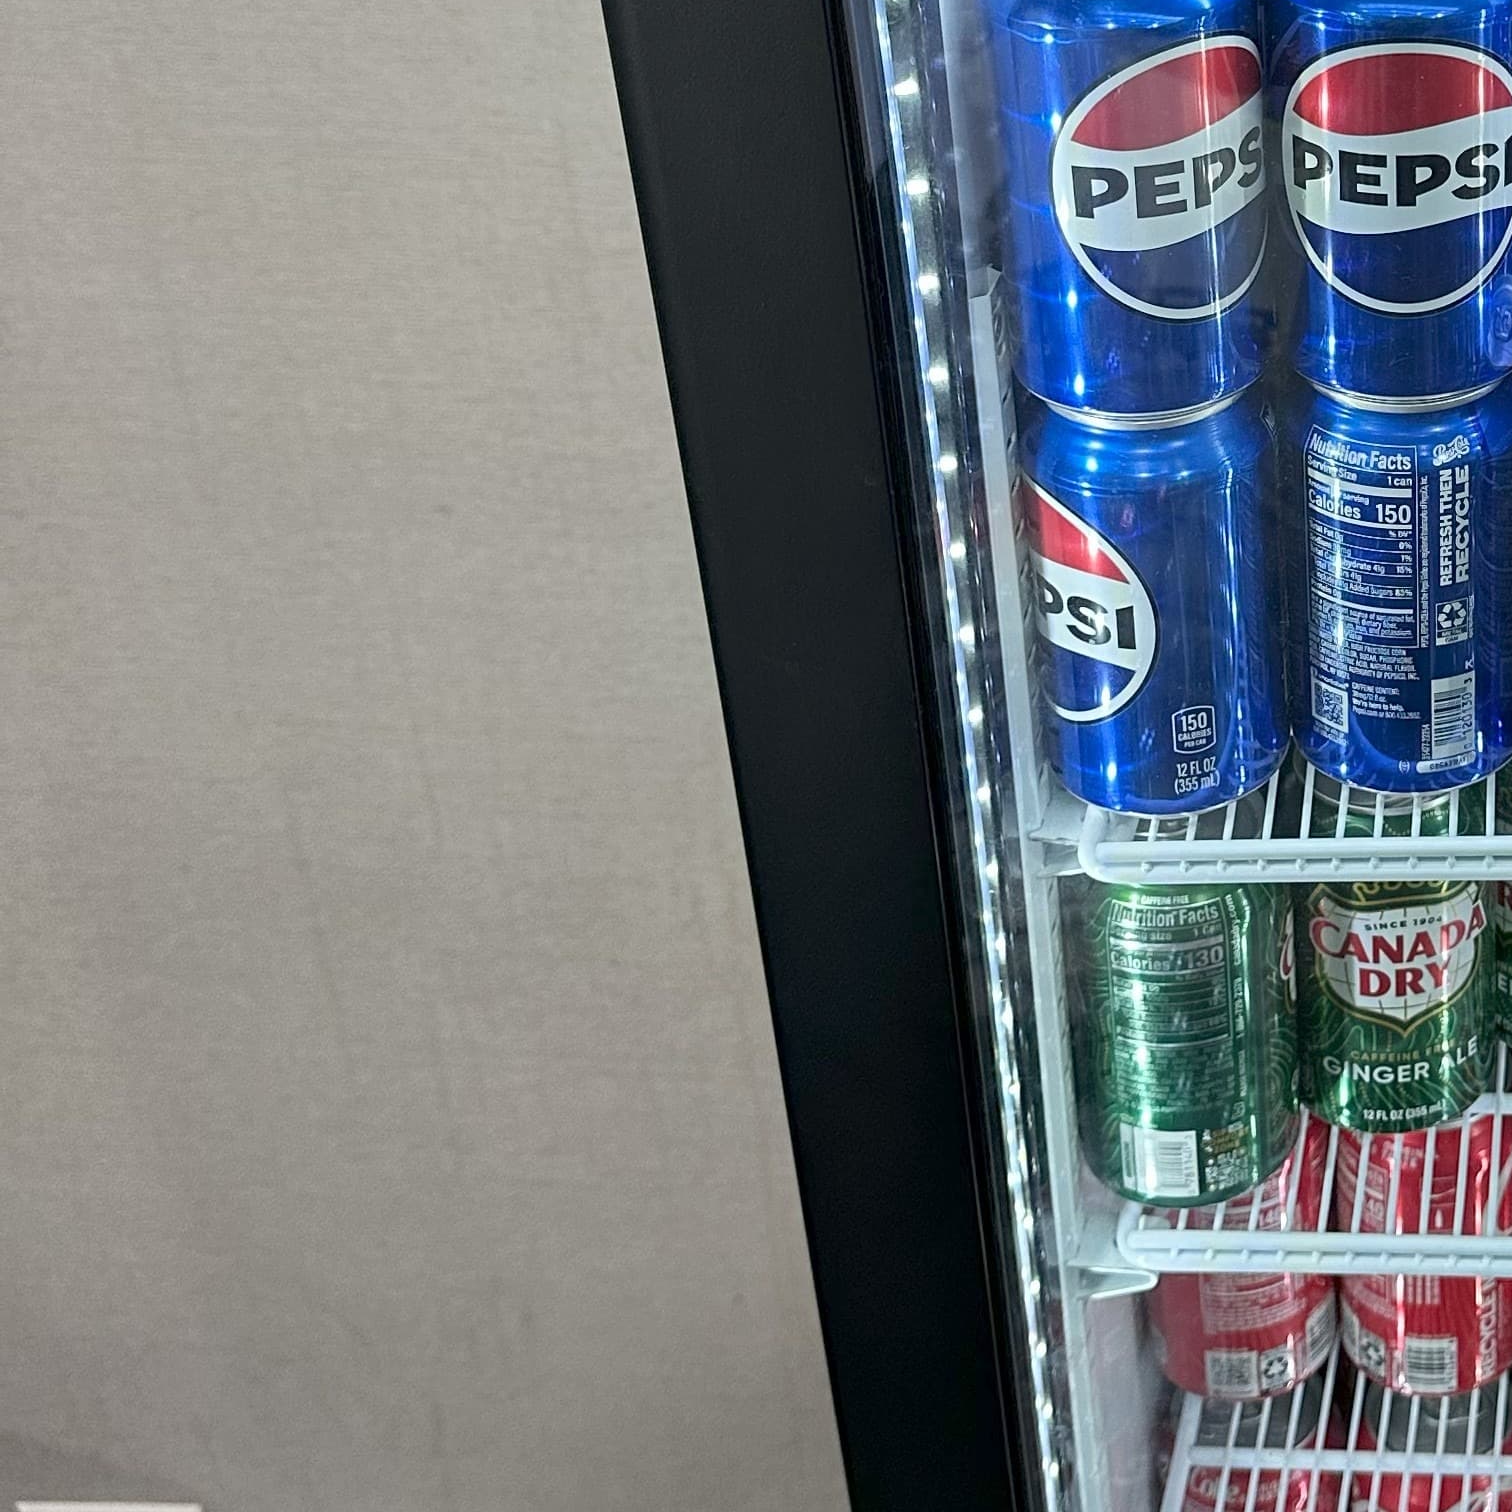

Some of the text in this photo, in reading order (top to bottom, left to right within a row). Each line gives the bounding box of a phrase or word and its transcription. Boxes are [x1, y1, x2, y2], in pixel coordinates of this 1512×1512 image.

[1309, 433, 1412, 470] Nutrition Facts
[1307, 454, 1412, 486] Serving Size 1 can
[1308, 488, 1411, 523] Calories 150
[1440, 469, 1452, 586] REFRESH THEN
[1455, 465, 1469, 583] RECYCLE
[1399, 542, 1412, 550] 0%
[1401, 555, 1412, 563] 1%
[1178, 728, 1212, 741] CALORIES
[1180, 712, 1207, 732] 150
[1176, 756, 1216, 777] 12 FL OZ
[1174, 769, 1220, 795] (355 mL)
[1111, 903, 1219, 927] Nutrition Facts
[1364, 916, 1442, 931] SINCE 1904
[1310, 904, 1486, 964] CANADA
[1110, 946, 1223, 971] Calories 130
[1359, 957, 1451, 997] DRY
[1323, 1035, 1478, 1083] GINGER ALE
[1351, 1049, 1419, 1062] CAFFEINE
[1364, 1108, 1374, 1120] 12
[1376, 1108, 1388, 1120] FL
[1390, 1108, 1404, 1120] OZ
[1479, 1292, 1498, 1381] RECYCLE
